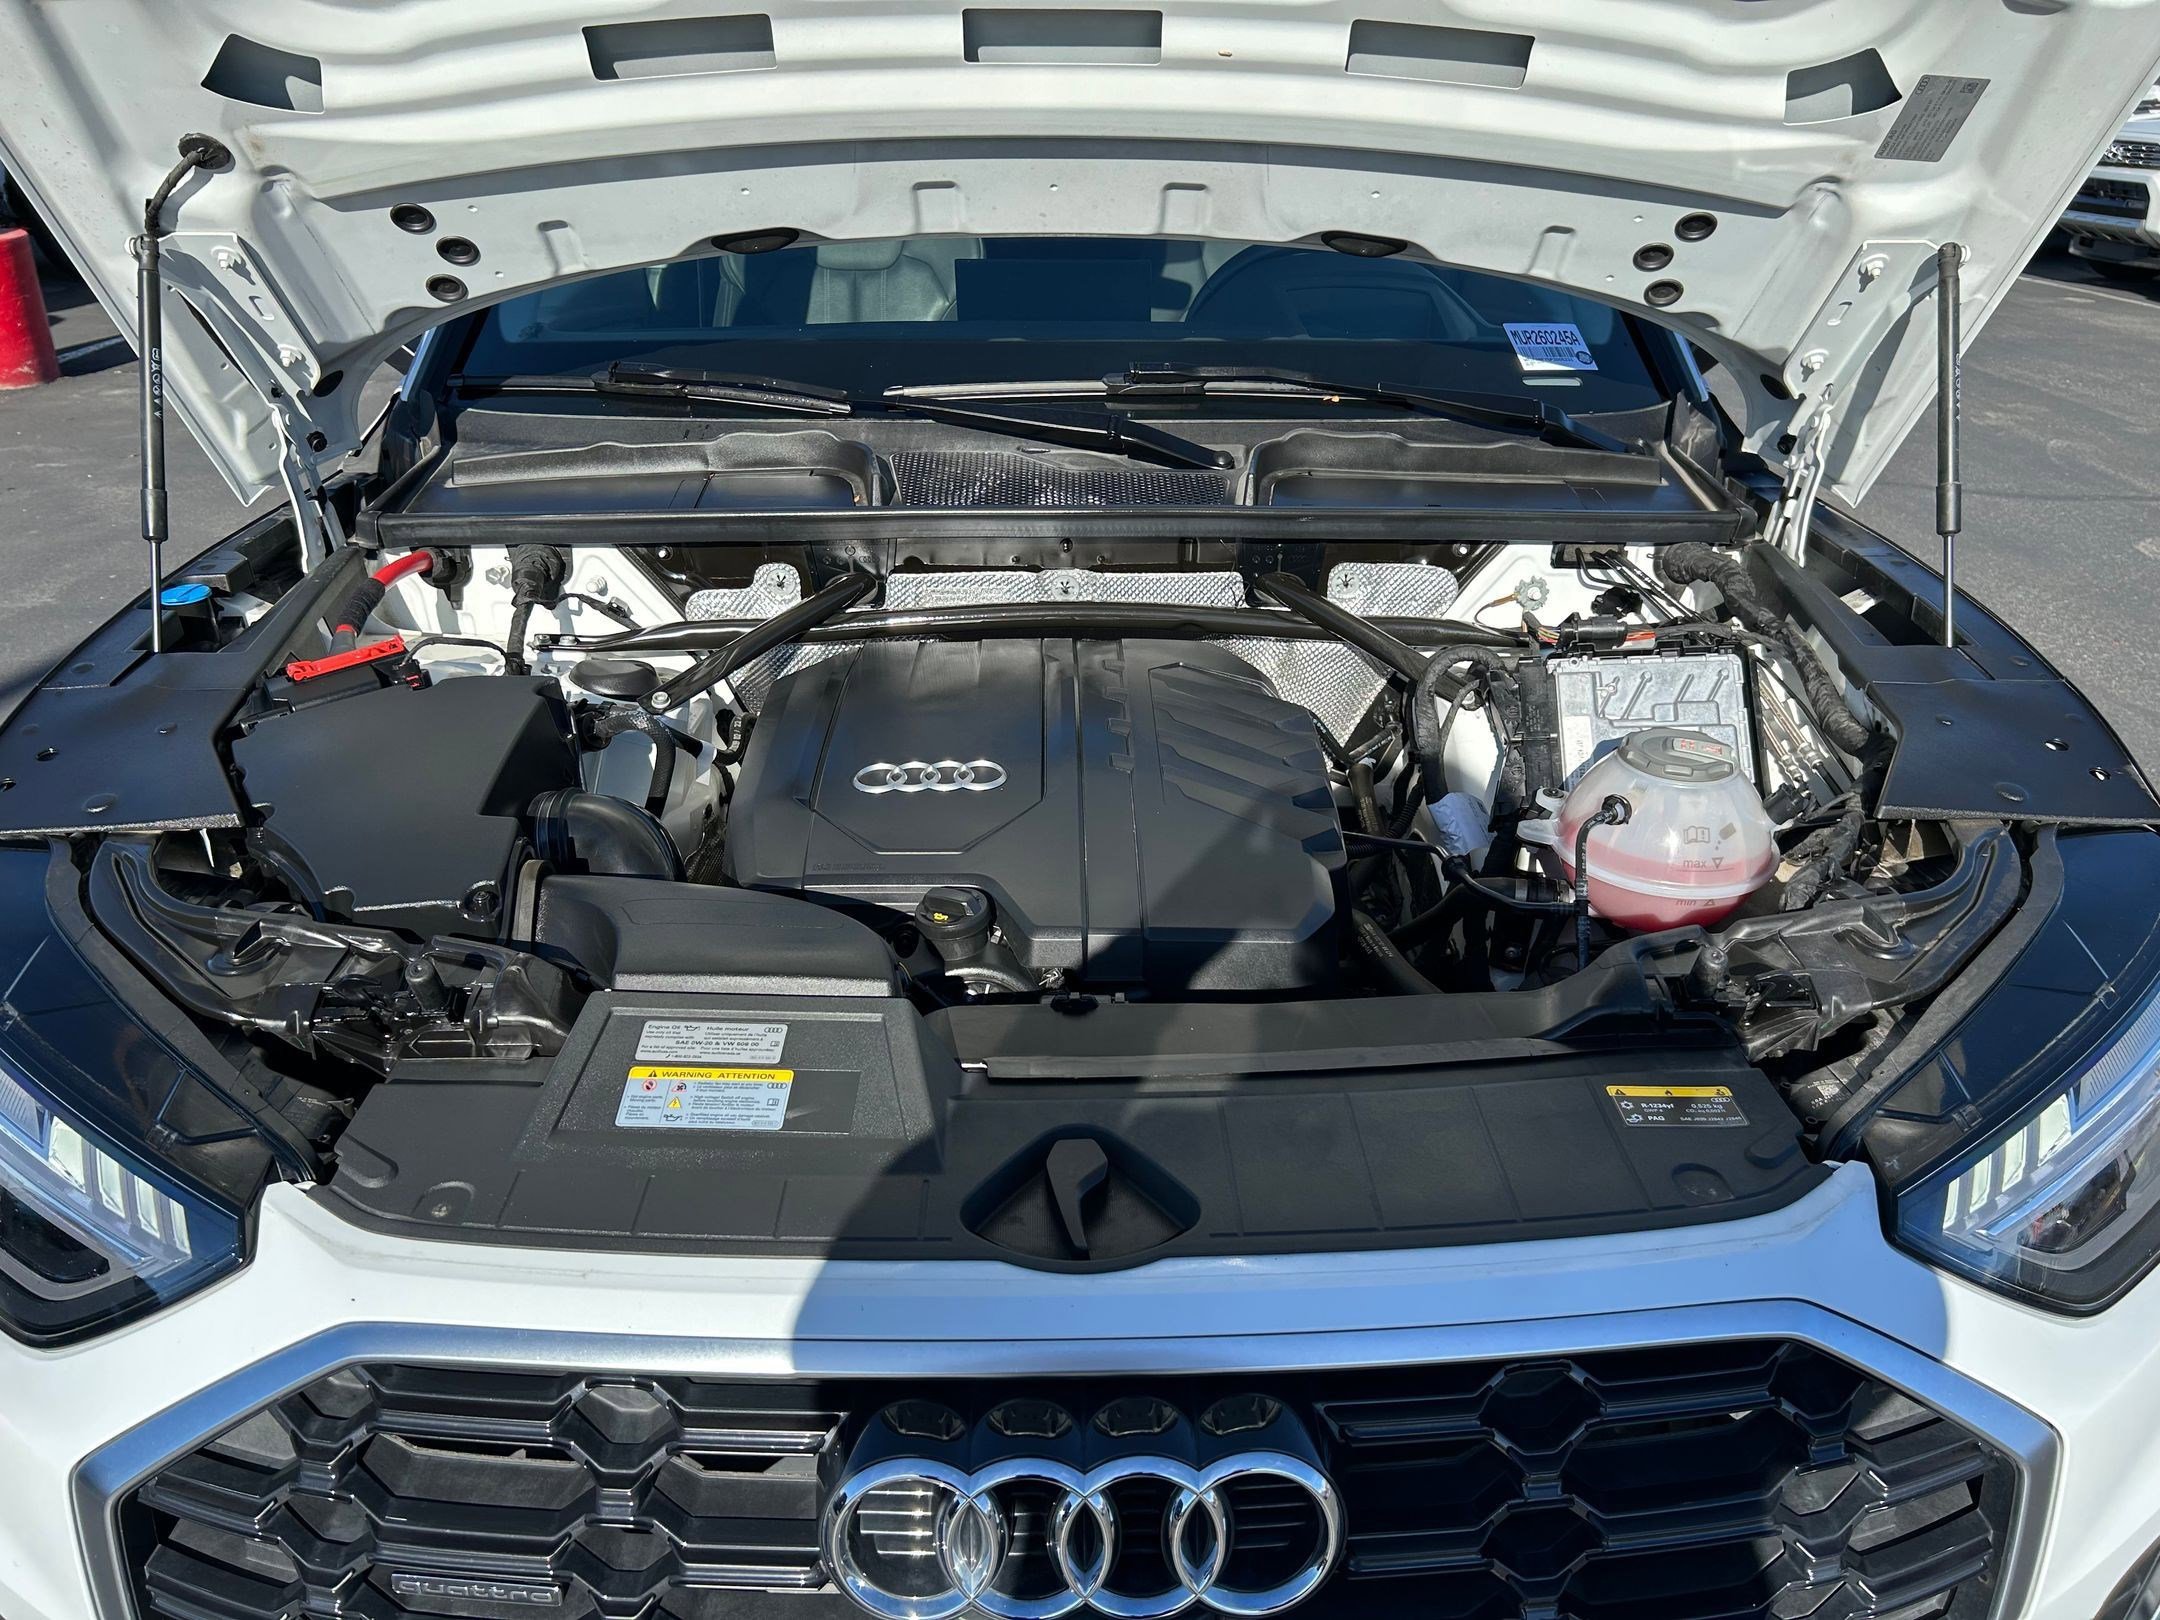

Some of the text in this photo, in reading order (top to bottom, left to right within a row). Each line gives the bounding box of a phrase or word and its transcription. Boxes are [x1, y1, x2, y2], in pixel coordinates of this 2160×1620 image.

[1510, 330, 1581, 346] MUR260245A
[1683, 860, 1706, 868] max
[398, 1580, 553, 1603] quattro
